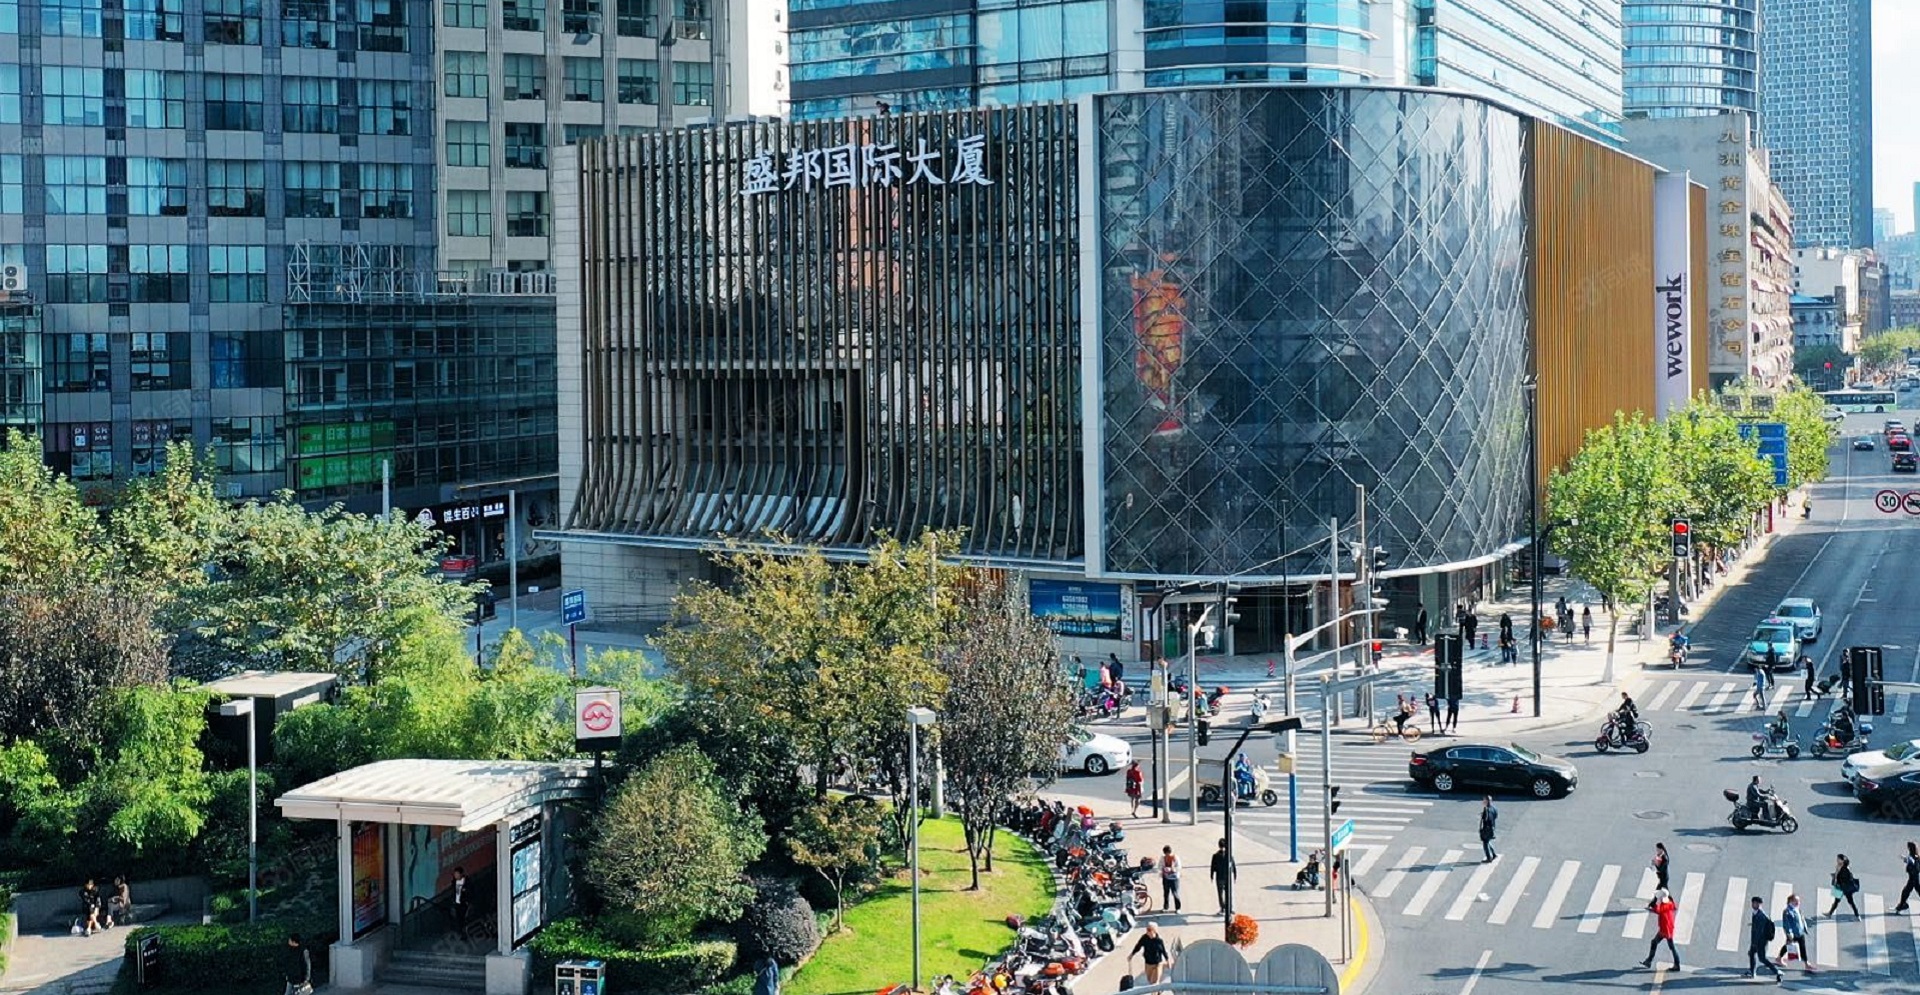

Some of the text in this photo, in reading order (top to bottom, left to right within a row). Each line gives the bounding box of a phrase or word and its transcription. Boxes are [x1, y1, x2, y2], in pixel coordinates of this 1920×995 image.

[739, 133, 995, 196] 盛邦国际大厦
[1656, 273, 1683, 380] wework
[1882, 495, 1896, 507] 30
